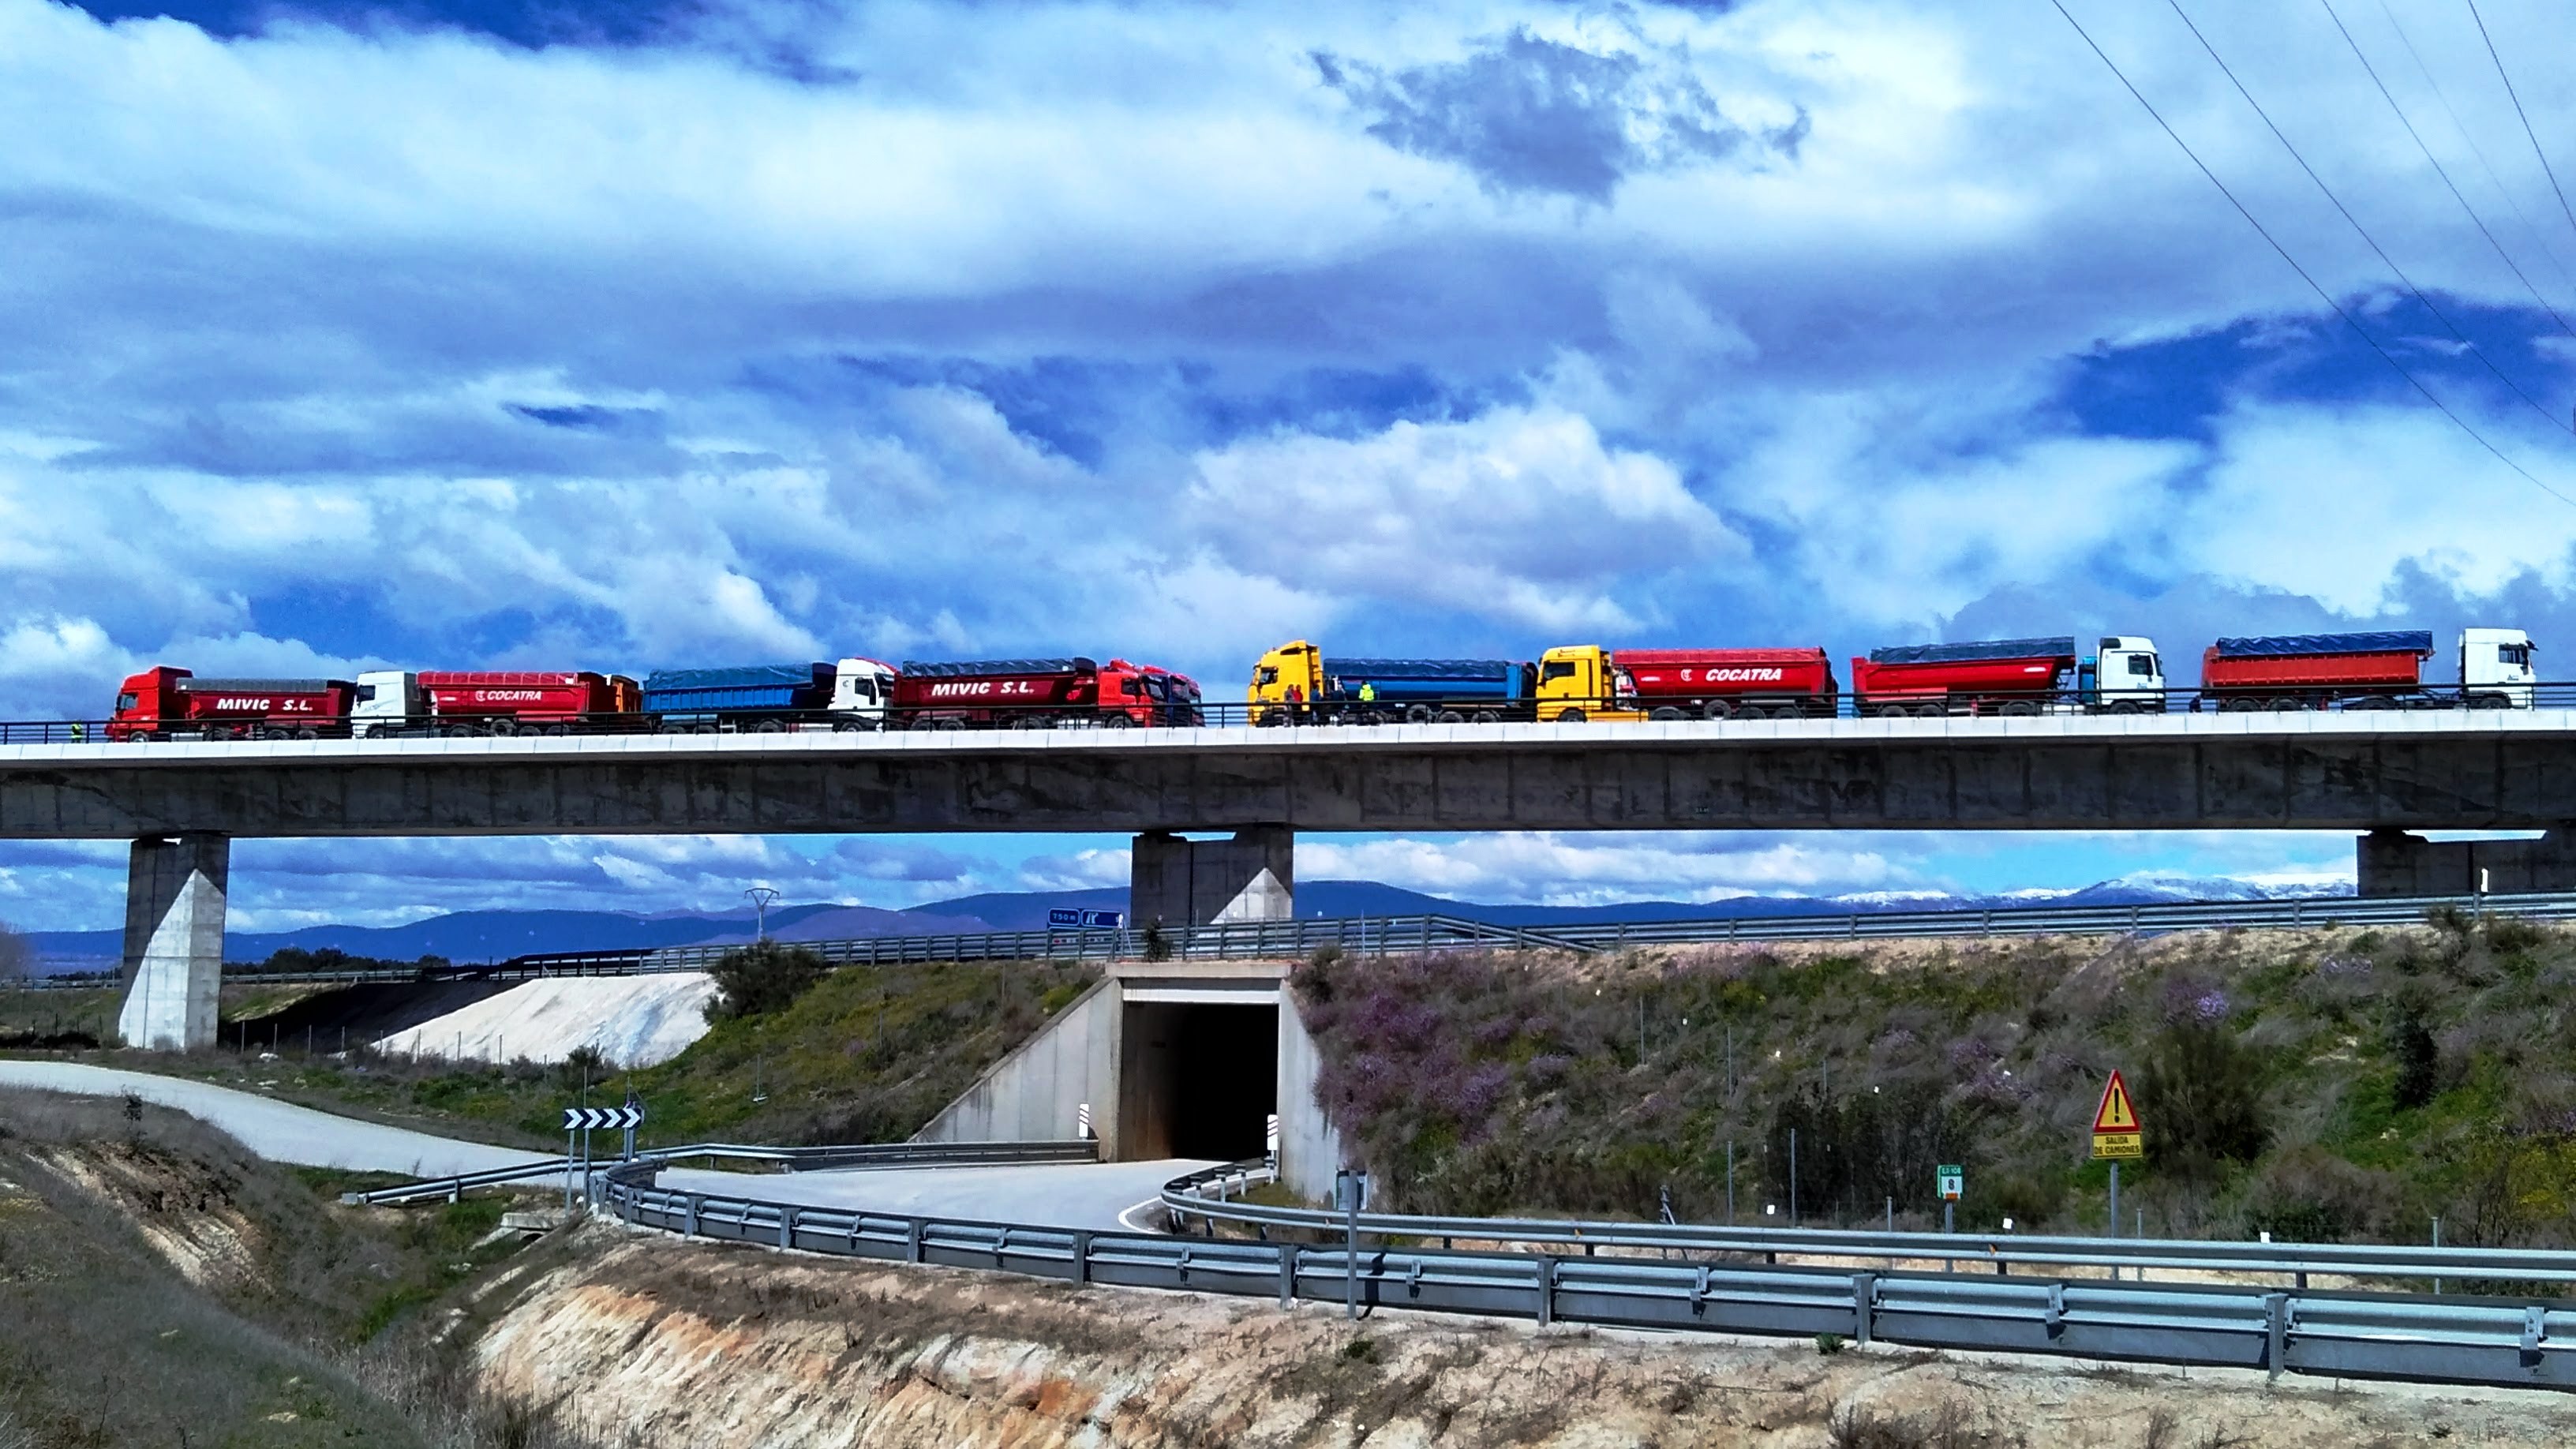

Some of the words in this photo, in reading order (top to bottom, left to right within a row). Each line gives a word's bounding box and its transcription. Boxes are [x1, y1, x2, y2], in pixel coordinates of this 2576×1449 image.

[1705, 668, 1782, 681] COCATRA
[931, 682, 991, 696] MIVIC
[1000, 681, 1035, 694] S.L.
[487, 690, 542, 701] COCATRA
[216, 698, 270, 710] MIVIC
[283, 699, 313, 711] S.L.
[1052, 912, 1069, 921] 750
[2105, 1145, 2140, 1154] CAMIONES
[1948, 1178, 1955, 1190] 8
